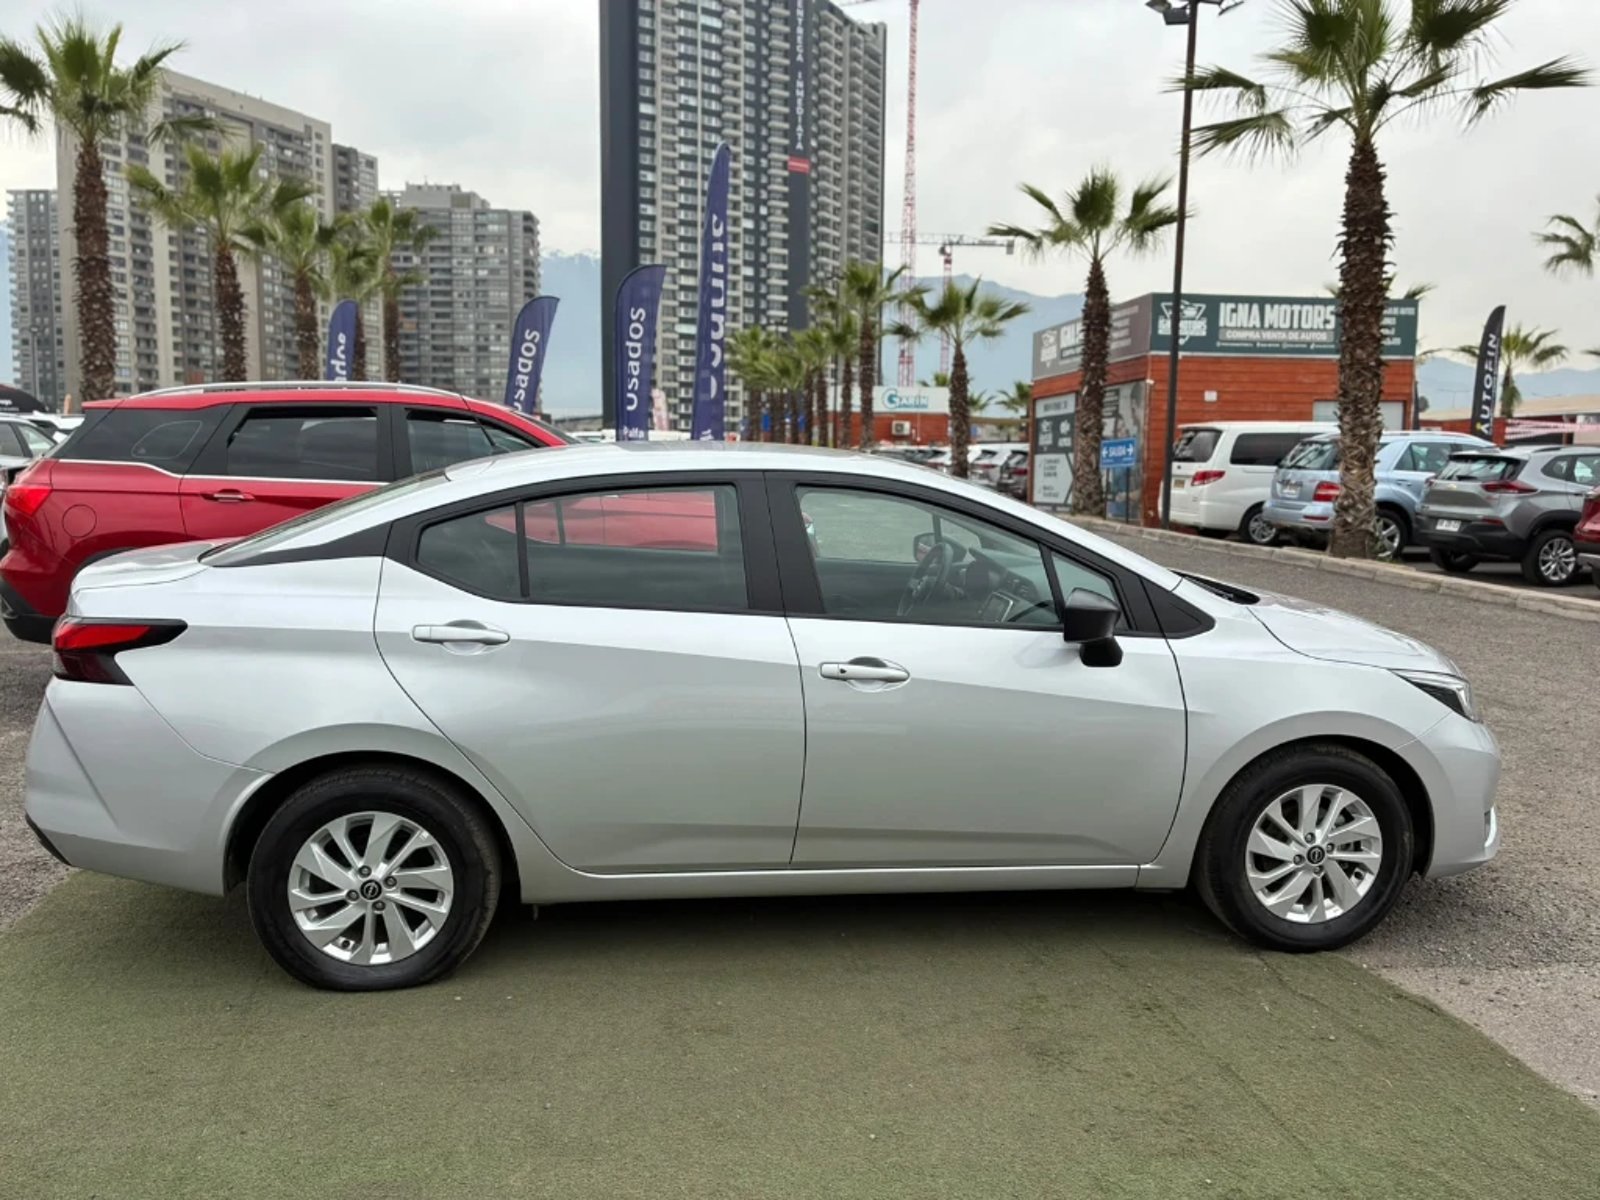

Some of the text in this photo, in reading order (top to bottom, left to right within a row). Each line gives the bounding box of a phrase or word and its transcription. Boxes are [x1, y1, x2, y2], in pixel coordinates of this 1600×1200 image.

[796, 71, 804, 149] INMEDIATA
[1219, 302, 1336, 329] IGNA MOTORS
[1226, 330, 1327, 341] COMPRA VENTA DE AUTOS
[626, 307, 646, 411] usados
[1480, 333, 1497, 434] AUTOFIN
